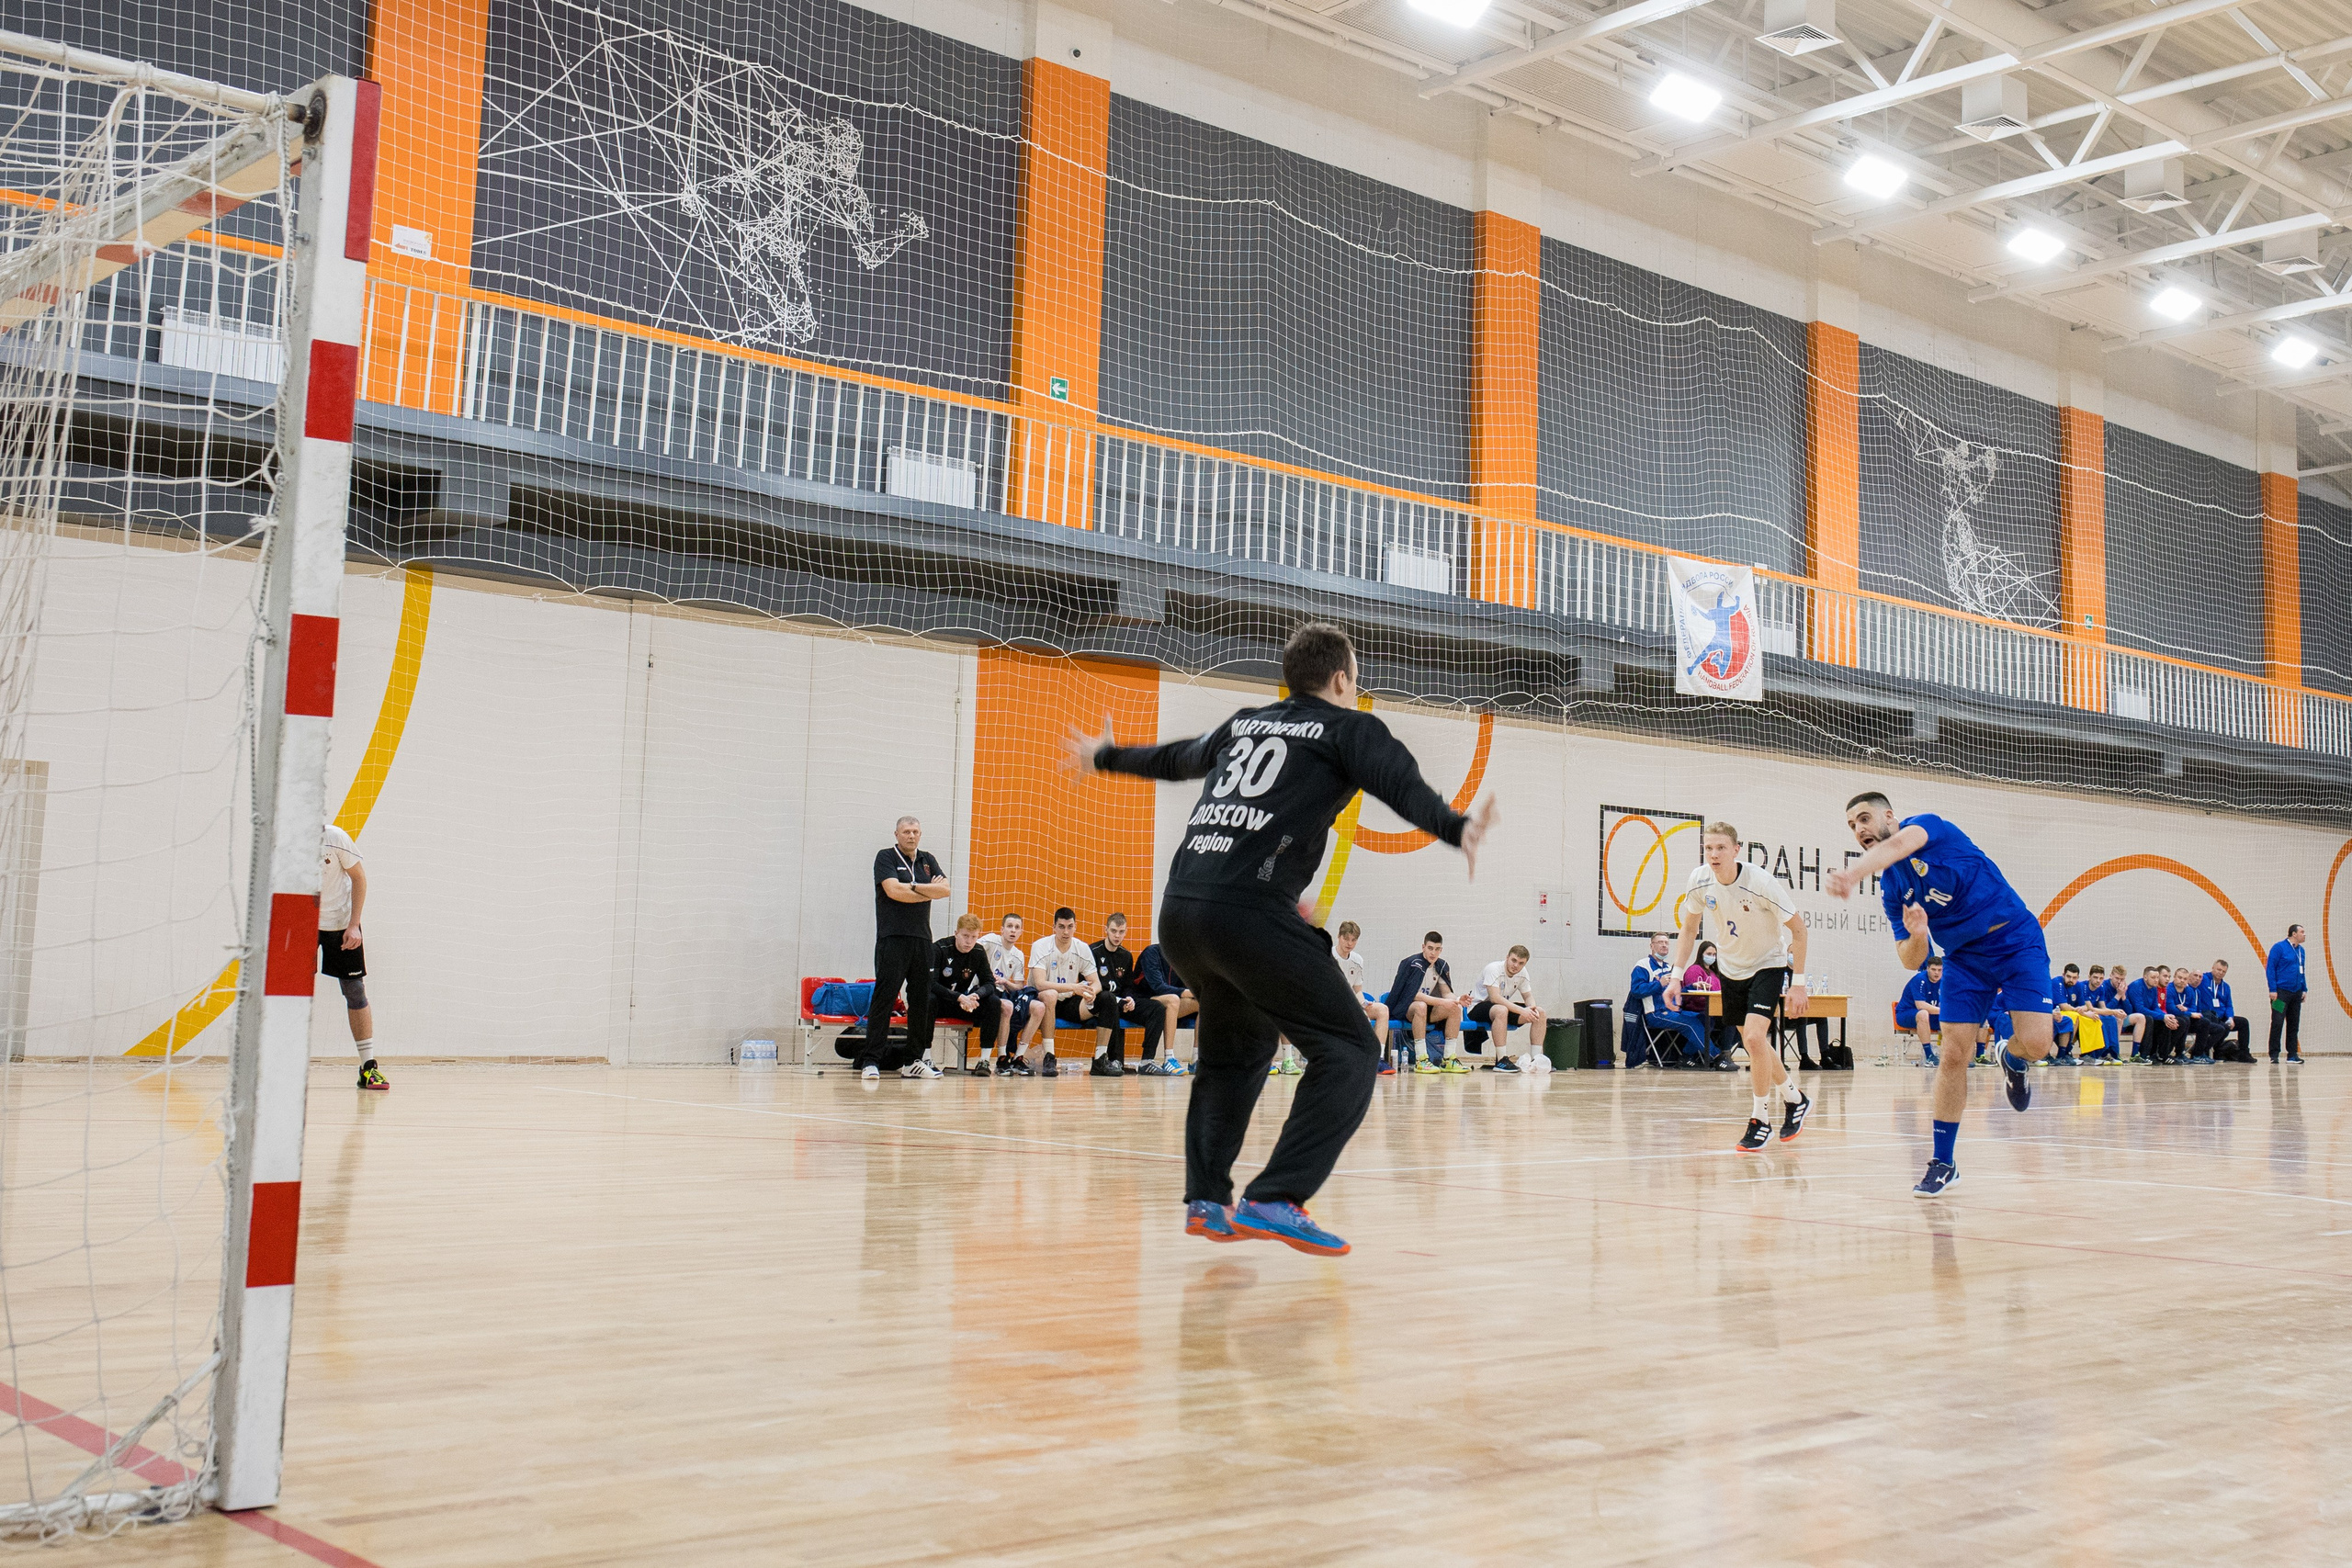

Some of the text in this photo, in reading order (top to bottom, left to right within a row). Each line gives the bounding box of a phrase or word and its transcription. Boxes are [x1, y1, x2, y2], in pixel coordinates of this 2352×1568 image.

[1212, 736, 1288, 798] 30
[1187, 831, 1234, 854] region
[1924, 887, 1953, 907] 10
[1726, 920, 1738, 938] 2
